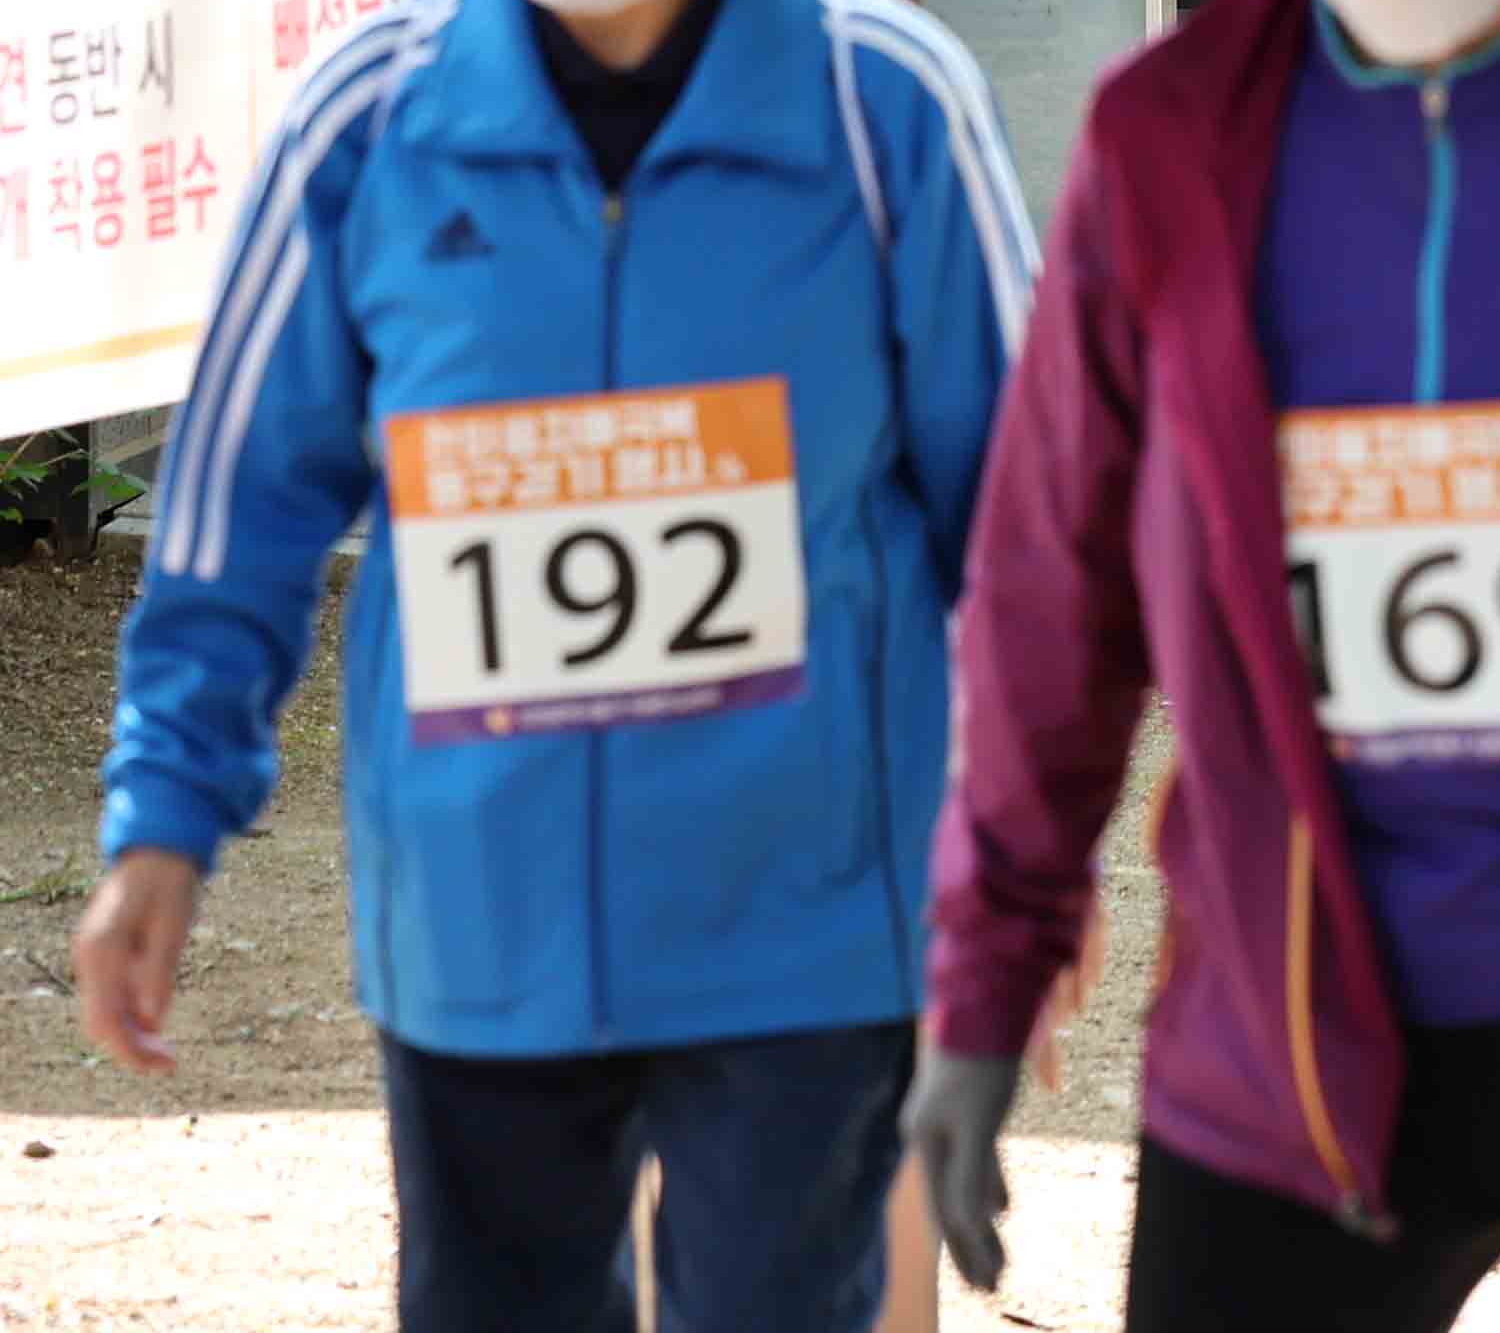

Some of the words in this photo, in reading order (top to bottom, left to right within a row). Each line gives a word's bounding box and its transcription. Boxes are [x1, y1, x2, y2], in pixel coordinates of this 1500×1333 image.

[47, 23, 123, 126] 동반
[138, 8, 176, 108] 시
[48, 150, 125, 250] 착용
[141, 135, 219, 241] 필수
[448, 515, 755, 673] 192
